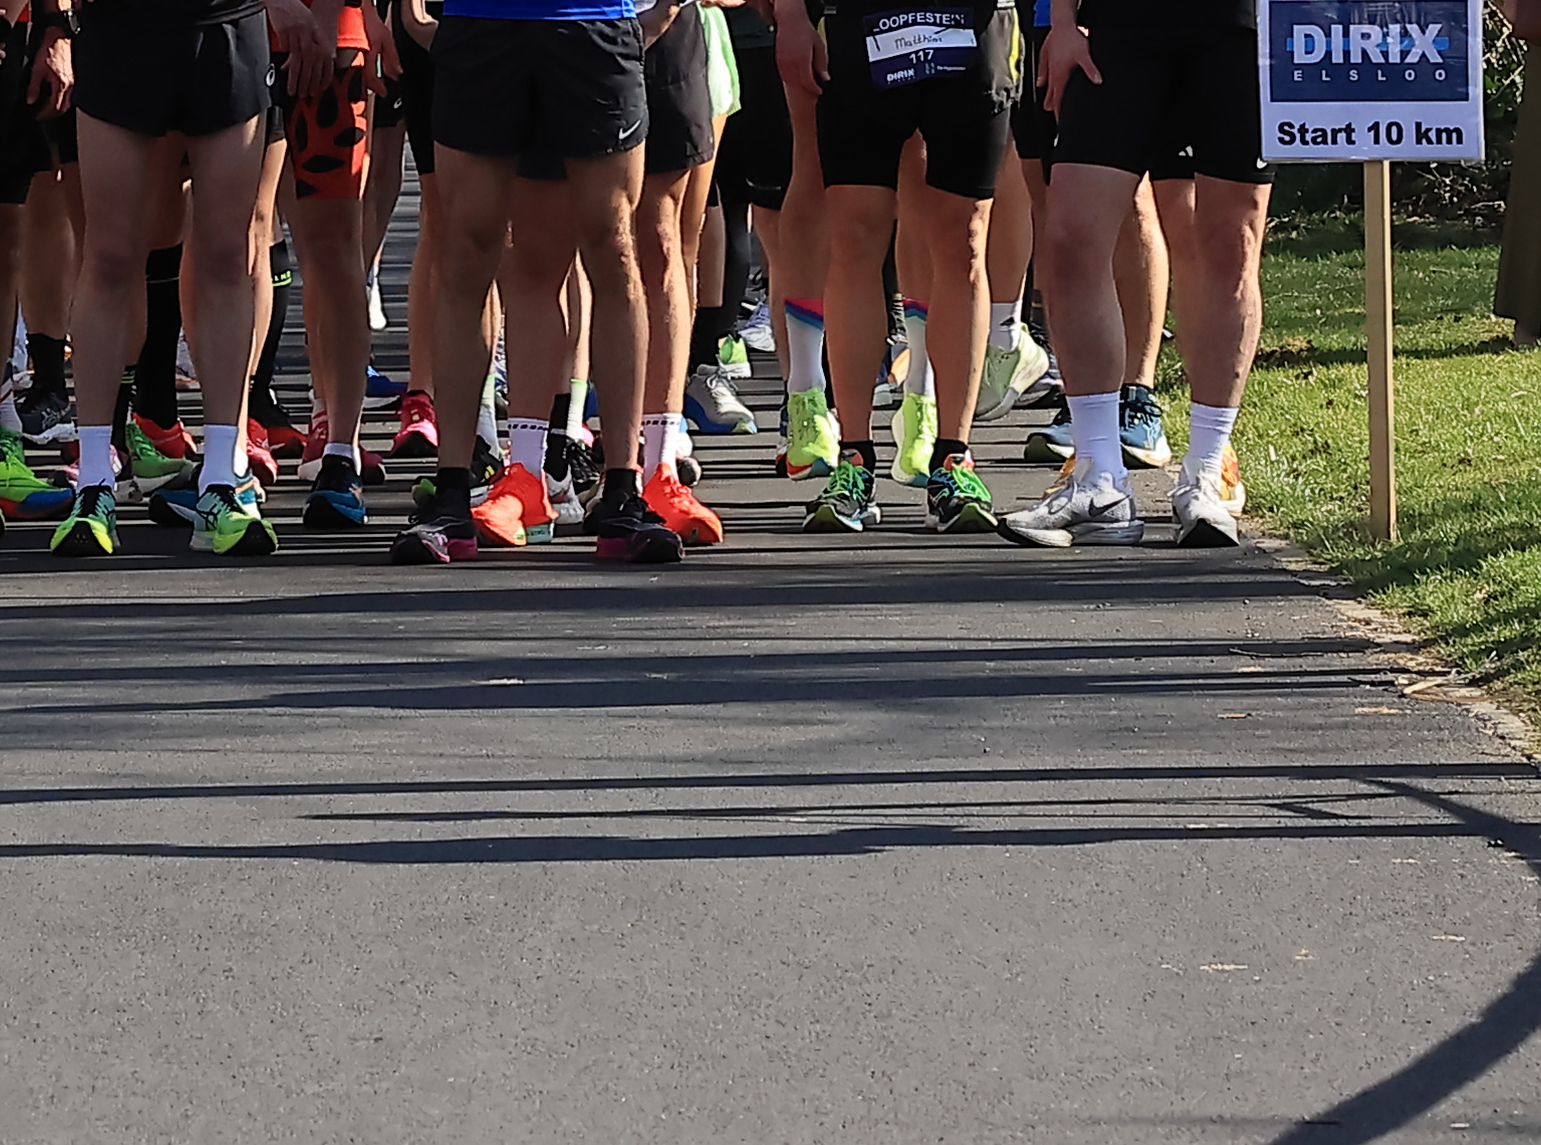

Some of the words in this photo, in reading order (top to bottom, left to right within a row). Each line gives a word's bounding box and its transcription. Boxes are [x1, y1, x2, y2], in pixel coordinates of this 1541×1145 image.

[873, 12, 965, 32] OOPFESTE
[1292, 23, 1444, 64] DIRIX
[908, 49, 934, 65] 117
[886, 68, 915, 83] DIRIX
[1293, 69, 1447, 82] ELSLOO
[1277, 121, 1356, 145] Start
[1366, 121, 1404, 145] 10
[1415, 121, 1464, 145] km
